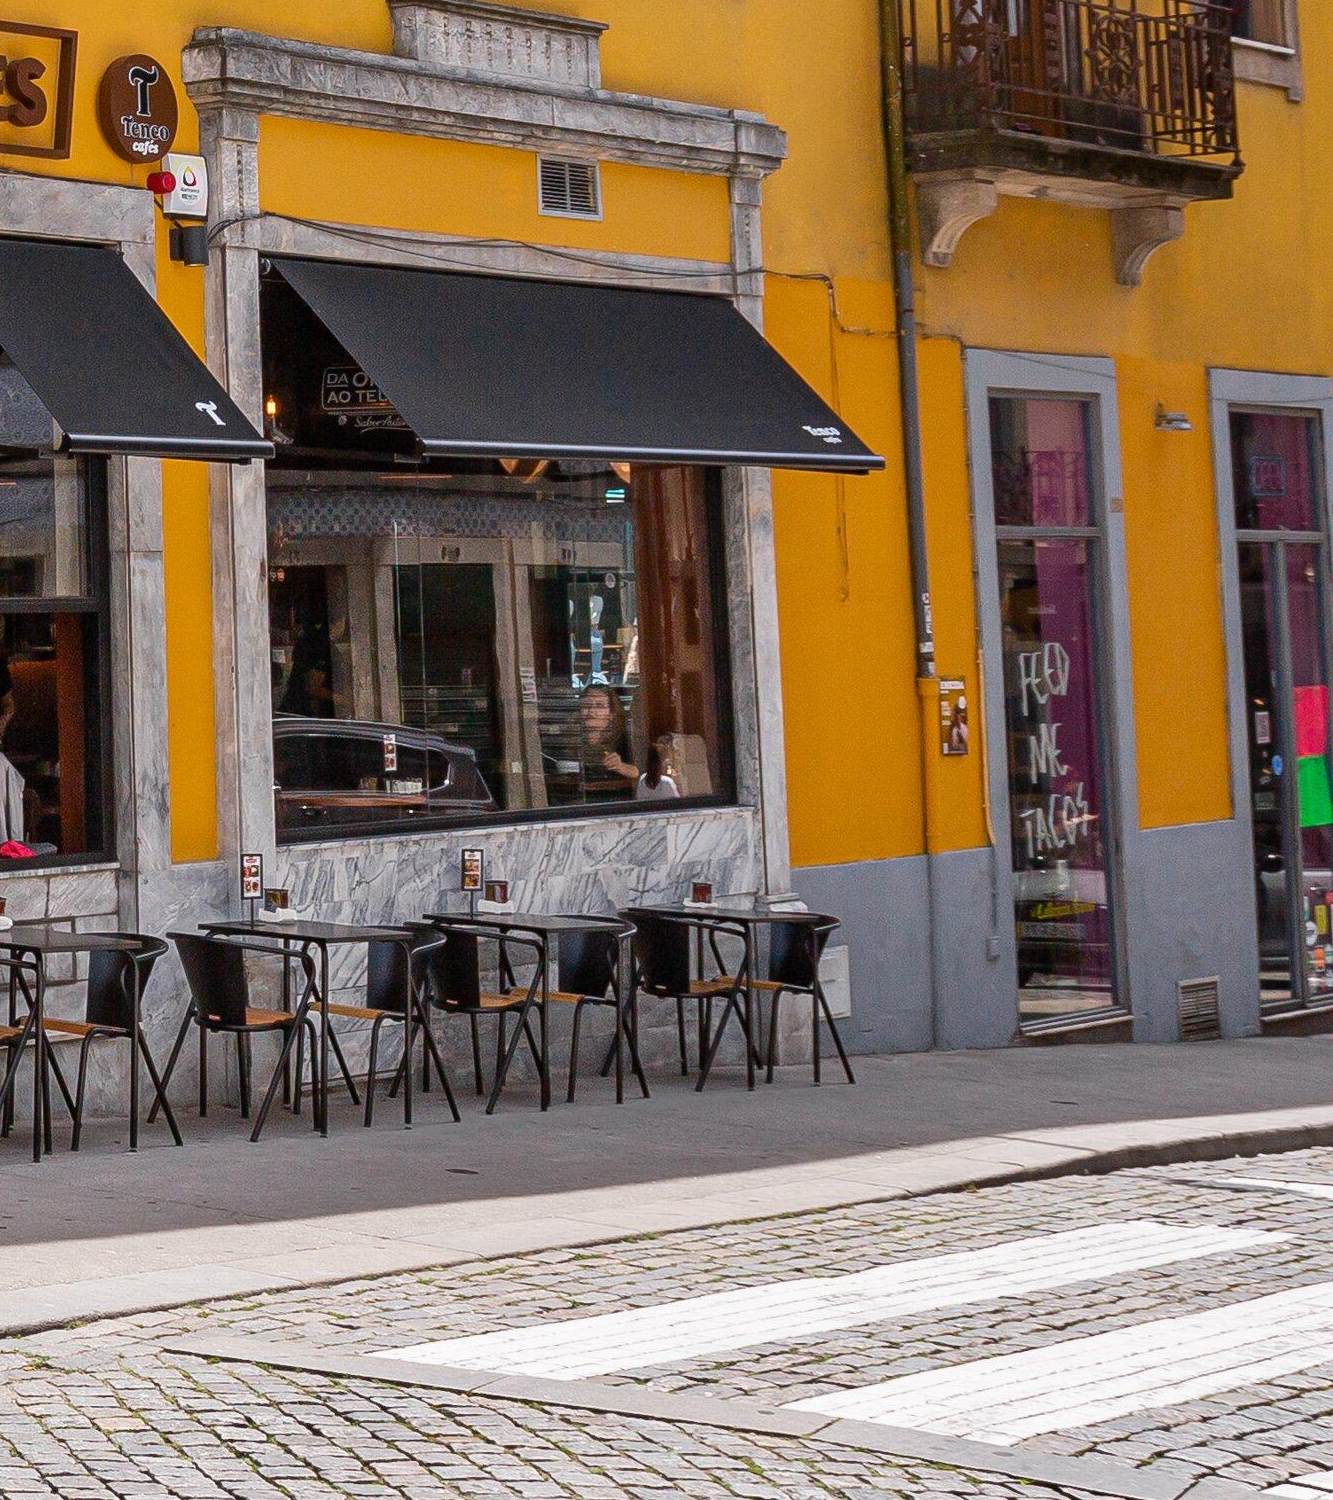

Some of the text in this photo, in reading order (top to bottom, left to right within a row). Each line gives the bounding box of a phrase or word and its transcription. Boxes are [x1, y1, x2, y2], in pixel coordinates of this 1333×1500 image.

[120, 114, 171, 143] Tenco
[326, 373, 349, 385] DA
[326, 390, 352, 404] AO
[1019, 642, 1070, 717] FEED
[1019, 781, 1089, 859] TACOS
